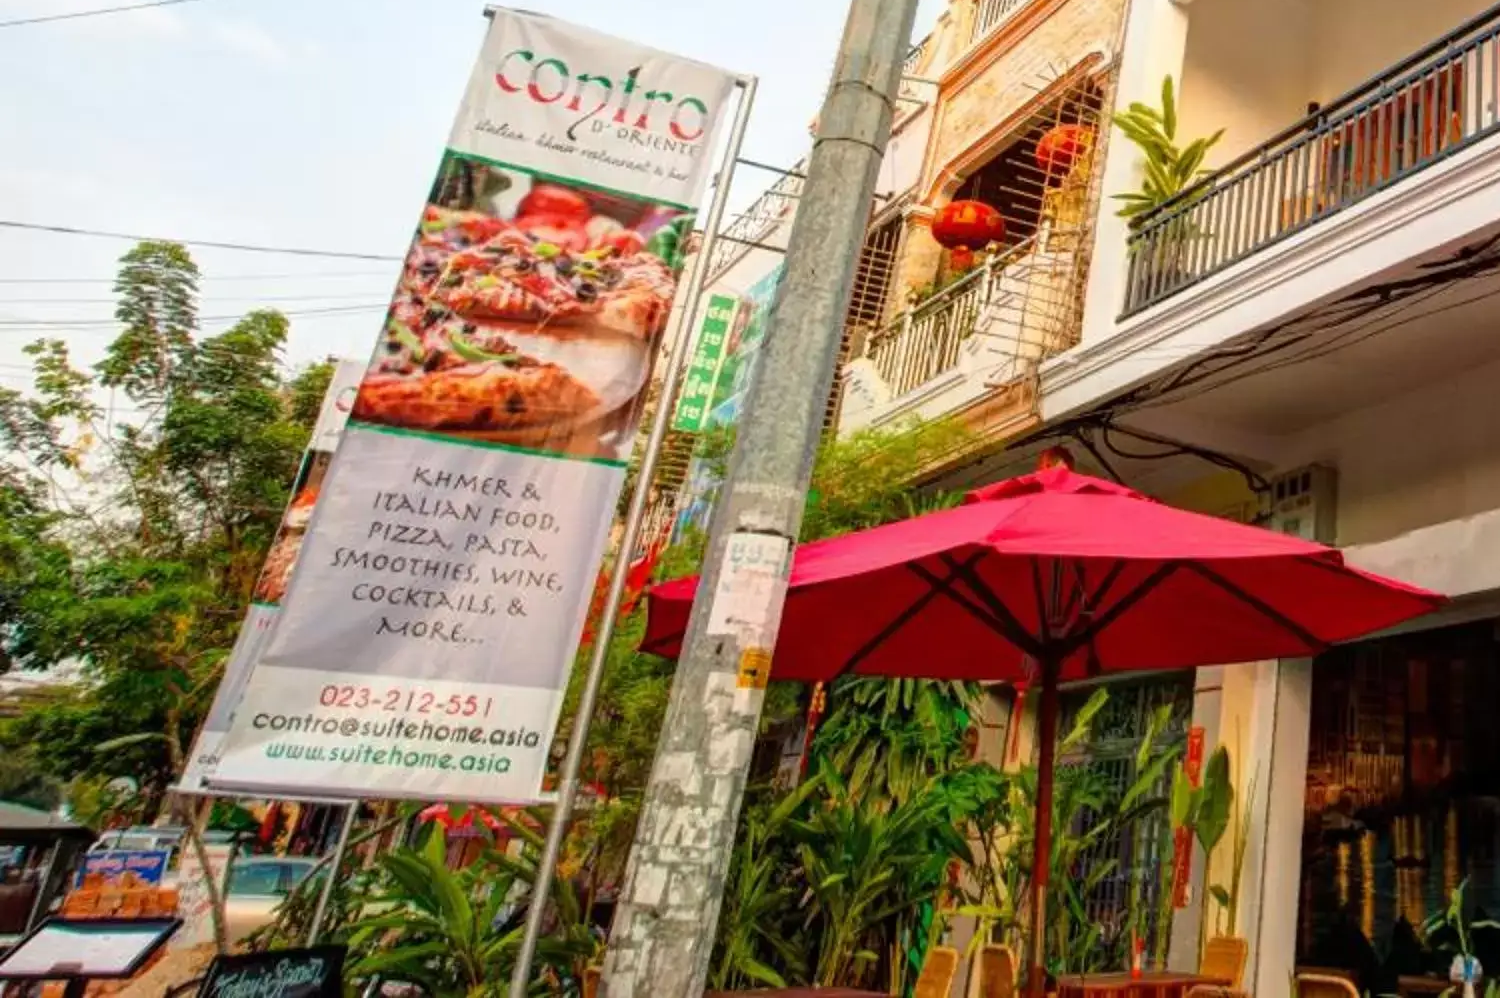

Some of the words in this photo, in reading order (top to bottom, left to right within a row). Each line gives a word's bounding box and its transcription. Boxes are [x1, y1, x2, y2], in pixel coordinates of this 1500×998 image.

[495, 49, 709, 142] contro
[616, 128, 702, 157] ORIENTE
[579, 146, 651, 173] restaurant
[668, 169, 689, 182] bar
[412, 466, 512, 499] KHMER
[521, 482, 541, 501] &
[372, 491, 482, 523] ITALIAN
[489, 508, 560, 534] FOOD,
[367, 521, 454, 551] PIZZA,
[463, 532, 548, 560] PASTA,
[330, 546, 480, 584] SMOOTHIES,
[491, 567, 564, 593] WINE,
[351, 583, 496, 616] COCKTAILS,
[506, 598, 528, 617] &
[375, 616, 484, 645] MORE...
[319, 684, 494, 719] 023-212-551
[251, 711, 542, 750] contro@suitehome.asia
[265, 741, 512, 774] www.suitehome.asia
